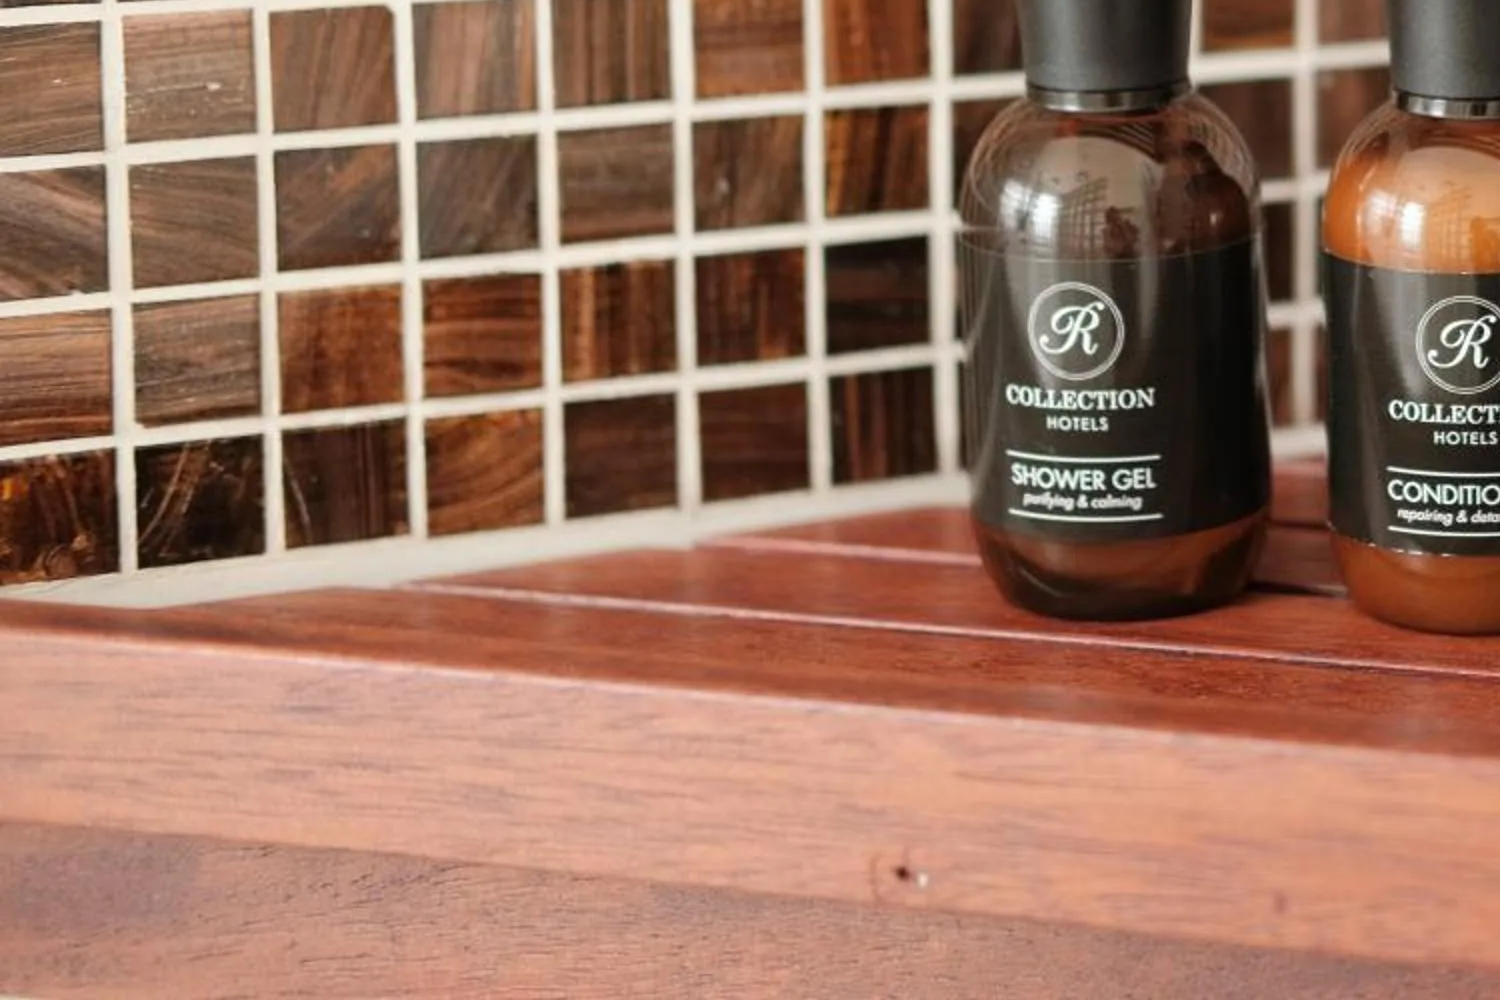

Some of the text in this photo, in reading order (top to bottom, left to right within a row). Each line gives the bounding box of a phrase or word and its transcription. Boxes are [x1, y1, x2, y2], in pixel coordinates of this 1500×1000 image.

[1039, 301, 1105, 355] R
[1427, 314, 1497, 369] R
[1005, 383, 1156, 411] COLLECTION
[1046, 415, 1109, 432] HOTELS
[1433, 431, 1498, 446] HOTELS
[1011, 462, 1157, 491] SHOWER GEL
[1022, 493, 1143, 511] purifying & calming
[1397, 507, 1453, 527] repairing
[1456, 509, 1469, 524] &
